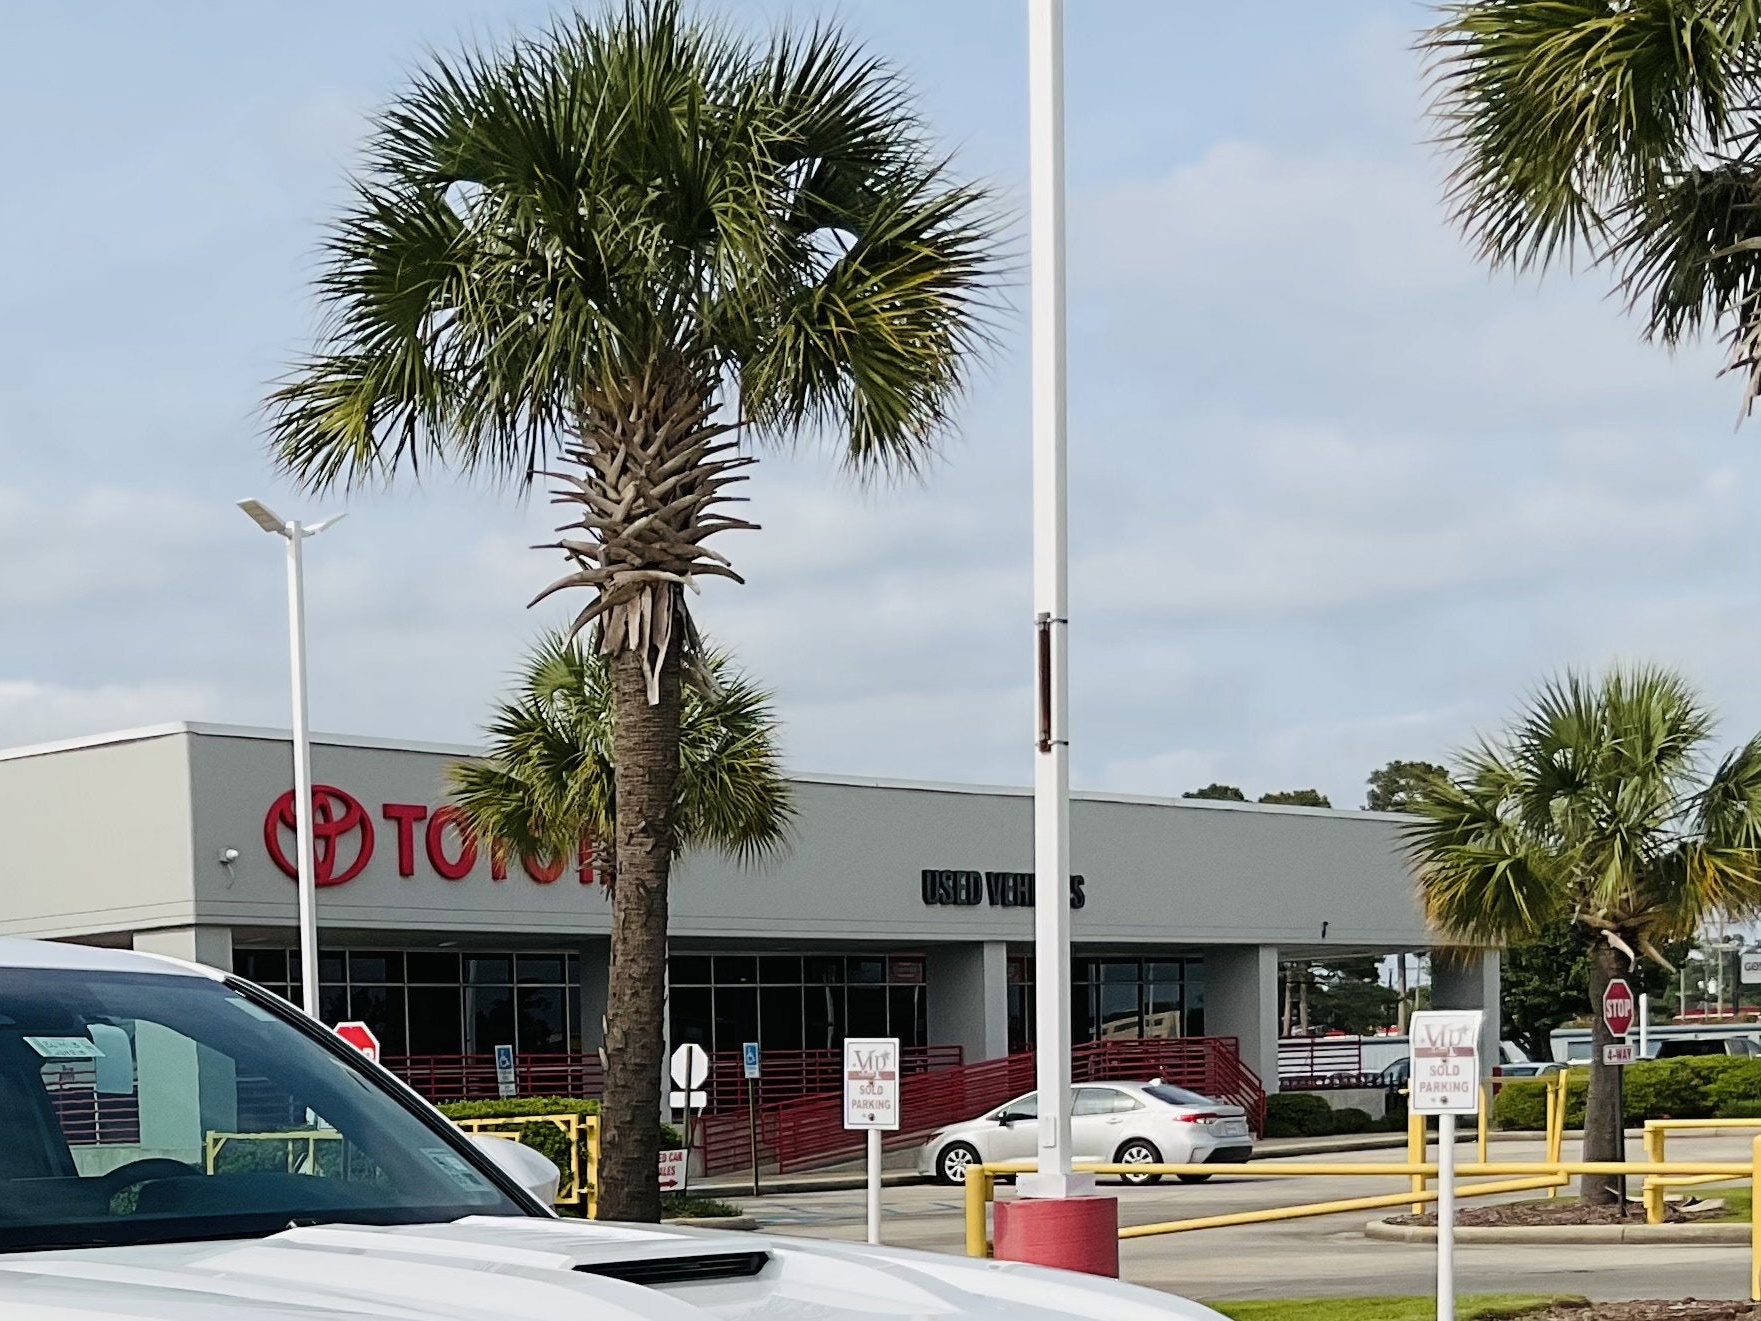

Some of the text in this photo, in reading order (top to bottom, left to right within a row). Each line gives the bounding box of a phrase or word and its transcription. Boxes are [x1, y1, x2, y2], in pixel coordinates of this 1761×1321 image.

[921, 869, 1086, 909] USED VEHS
[1605, 998, 1632, 1019] STOP
[1607, 1047, 1632, 1061] 4-WAY
[1429, 1064, 1460, 1076] SOLD
[859, 1085, 884, 1095] SOLD
[1419, 1081, 1469, 1093] PARKING
[851, 1099, 891, 1110] PARKING
